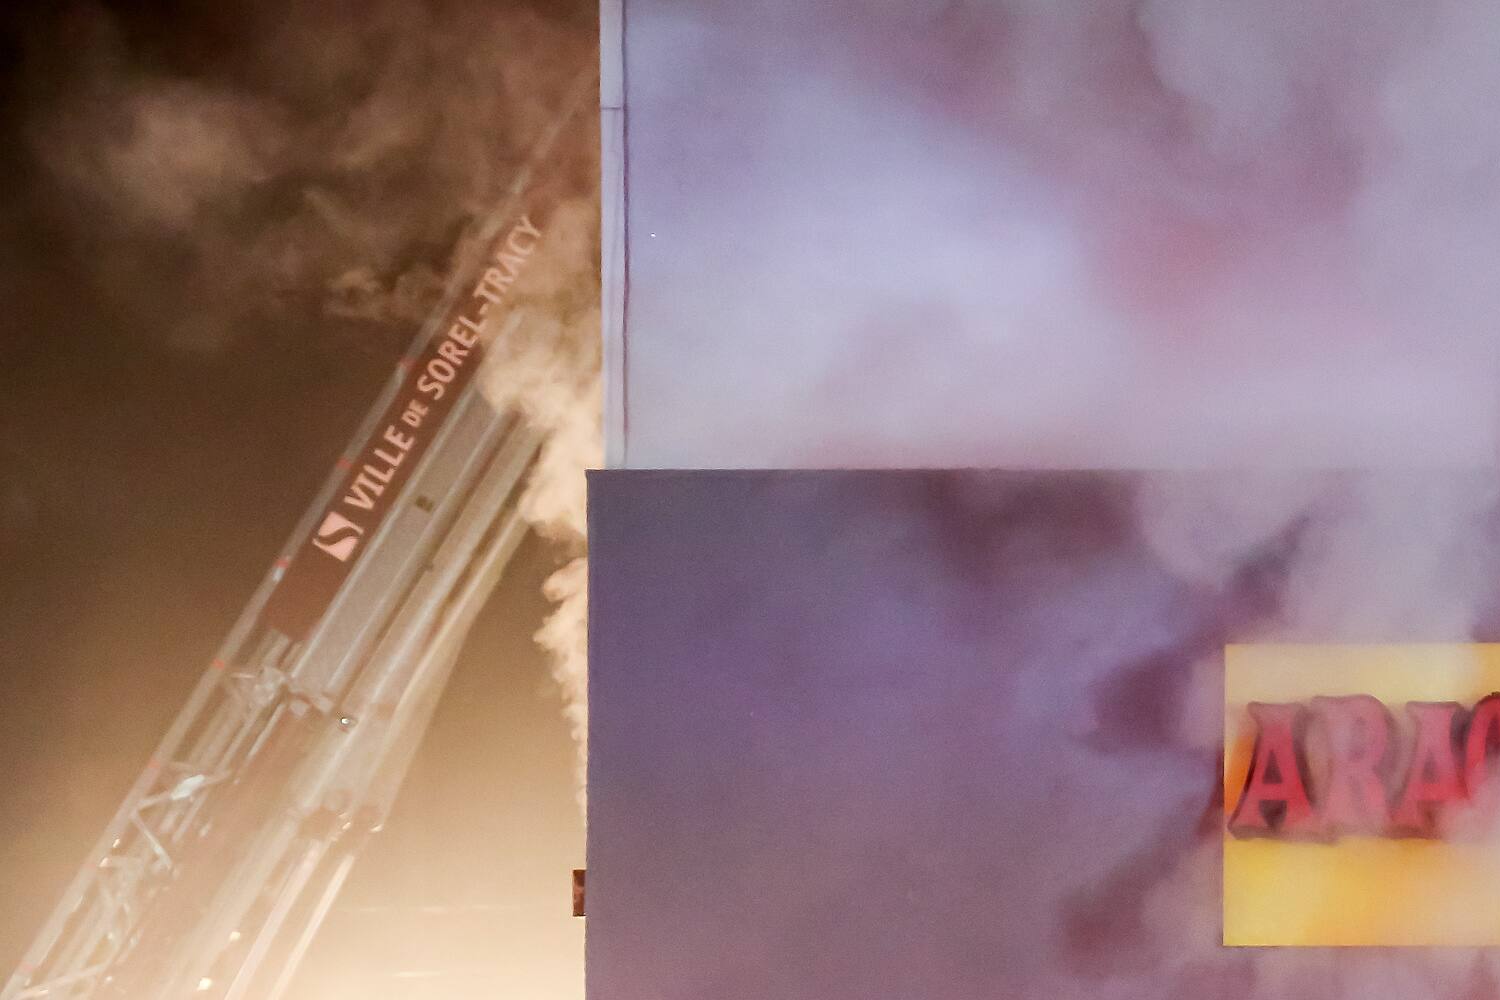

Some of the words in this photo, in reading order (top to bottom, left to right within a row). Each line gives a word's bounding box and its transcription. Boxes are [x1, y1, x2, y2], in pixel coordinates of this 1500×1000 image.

[344, 424, 416, 511] VILLE
[401, 399, 429, 428] DE
[418, 215, 542, 400] SOREL-TRACY
